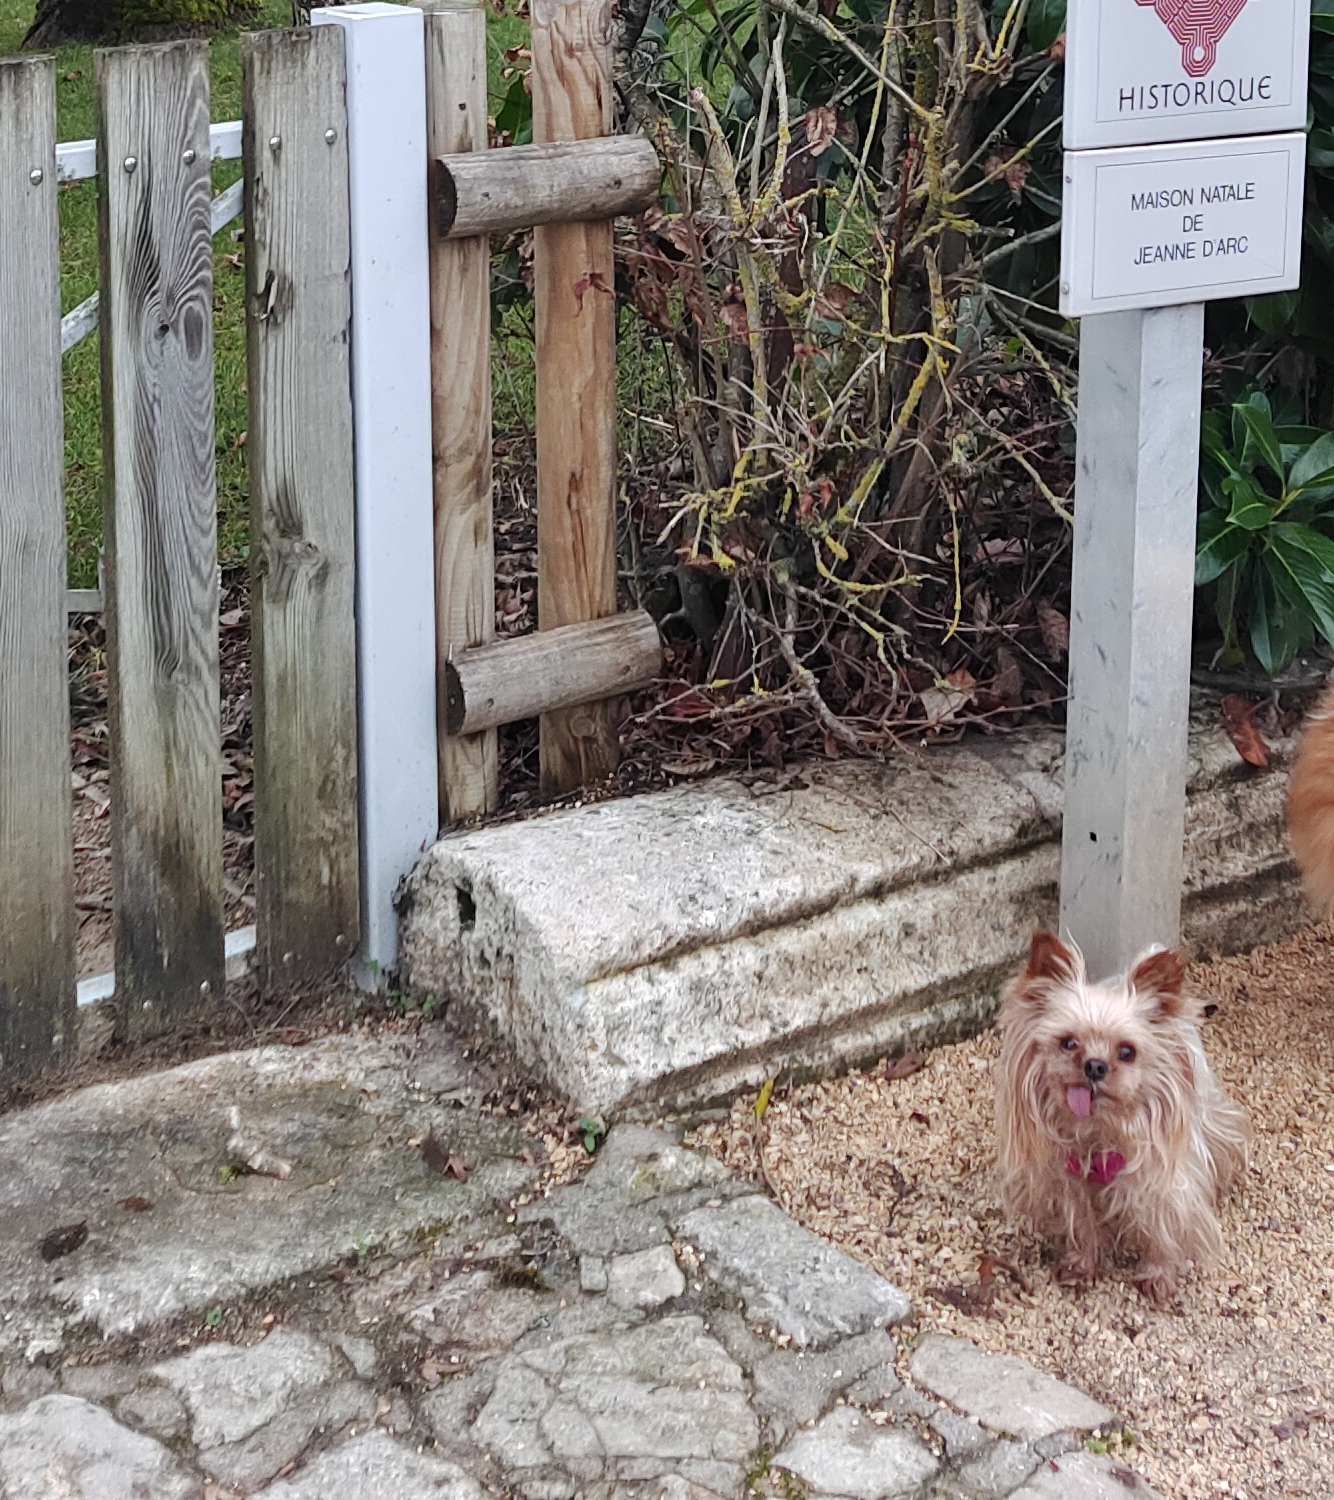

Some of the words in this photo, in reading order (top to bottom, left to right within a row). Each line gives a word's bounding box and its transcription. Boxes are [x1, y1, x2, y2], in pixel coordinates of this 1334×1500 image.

[1119, 76, 1272, 112] HISTORIQUE
[1131, 188, 1194, 211] MAISON
[1200, 183, 1255, 203] NATALE
[1182, 214, 1204, 232] DE
[1134, 242, 1196, 266] JEANNE
[1202, 236, 1249, 258] D'ARC
